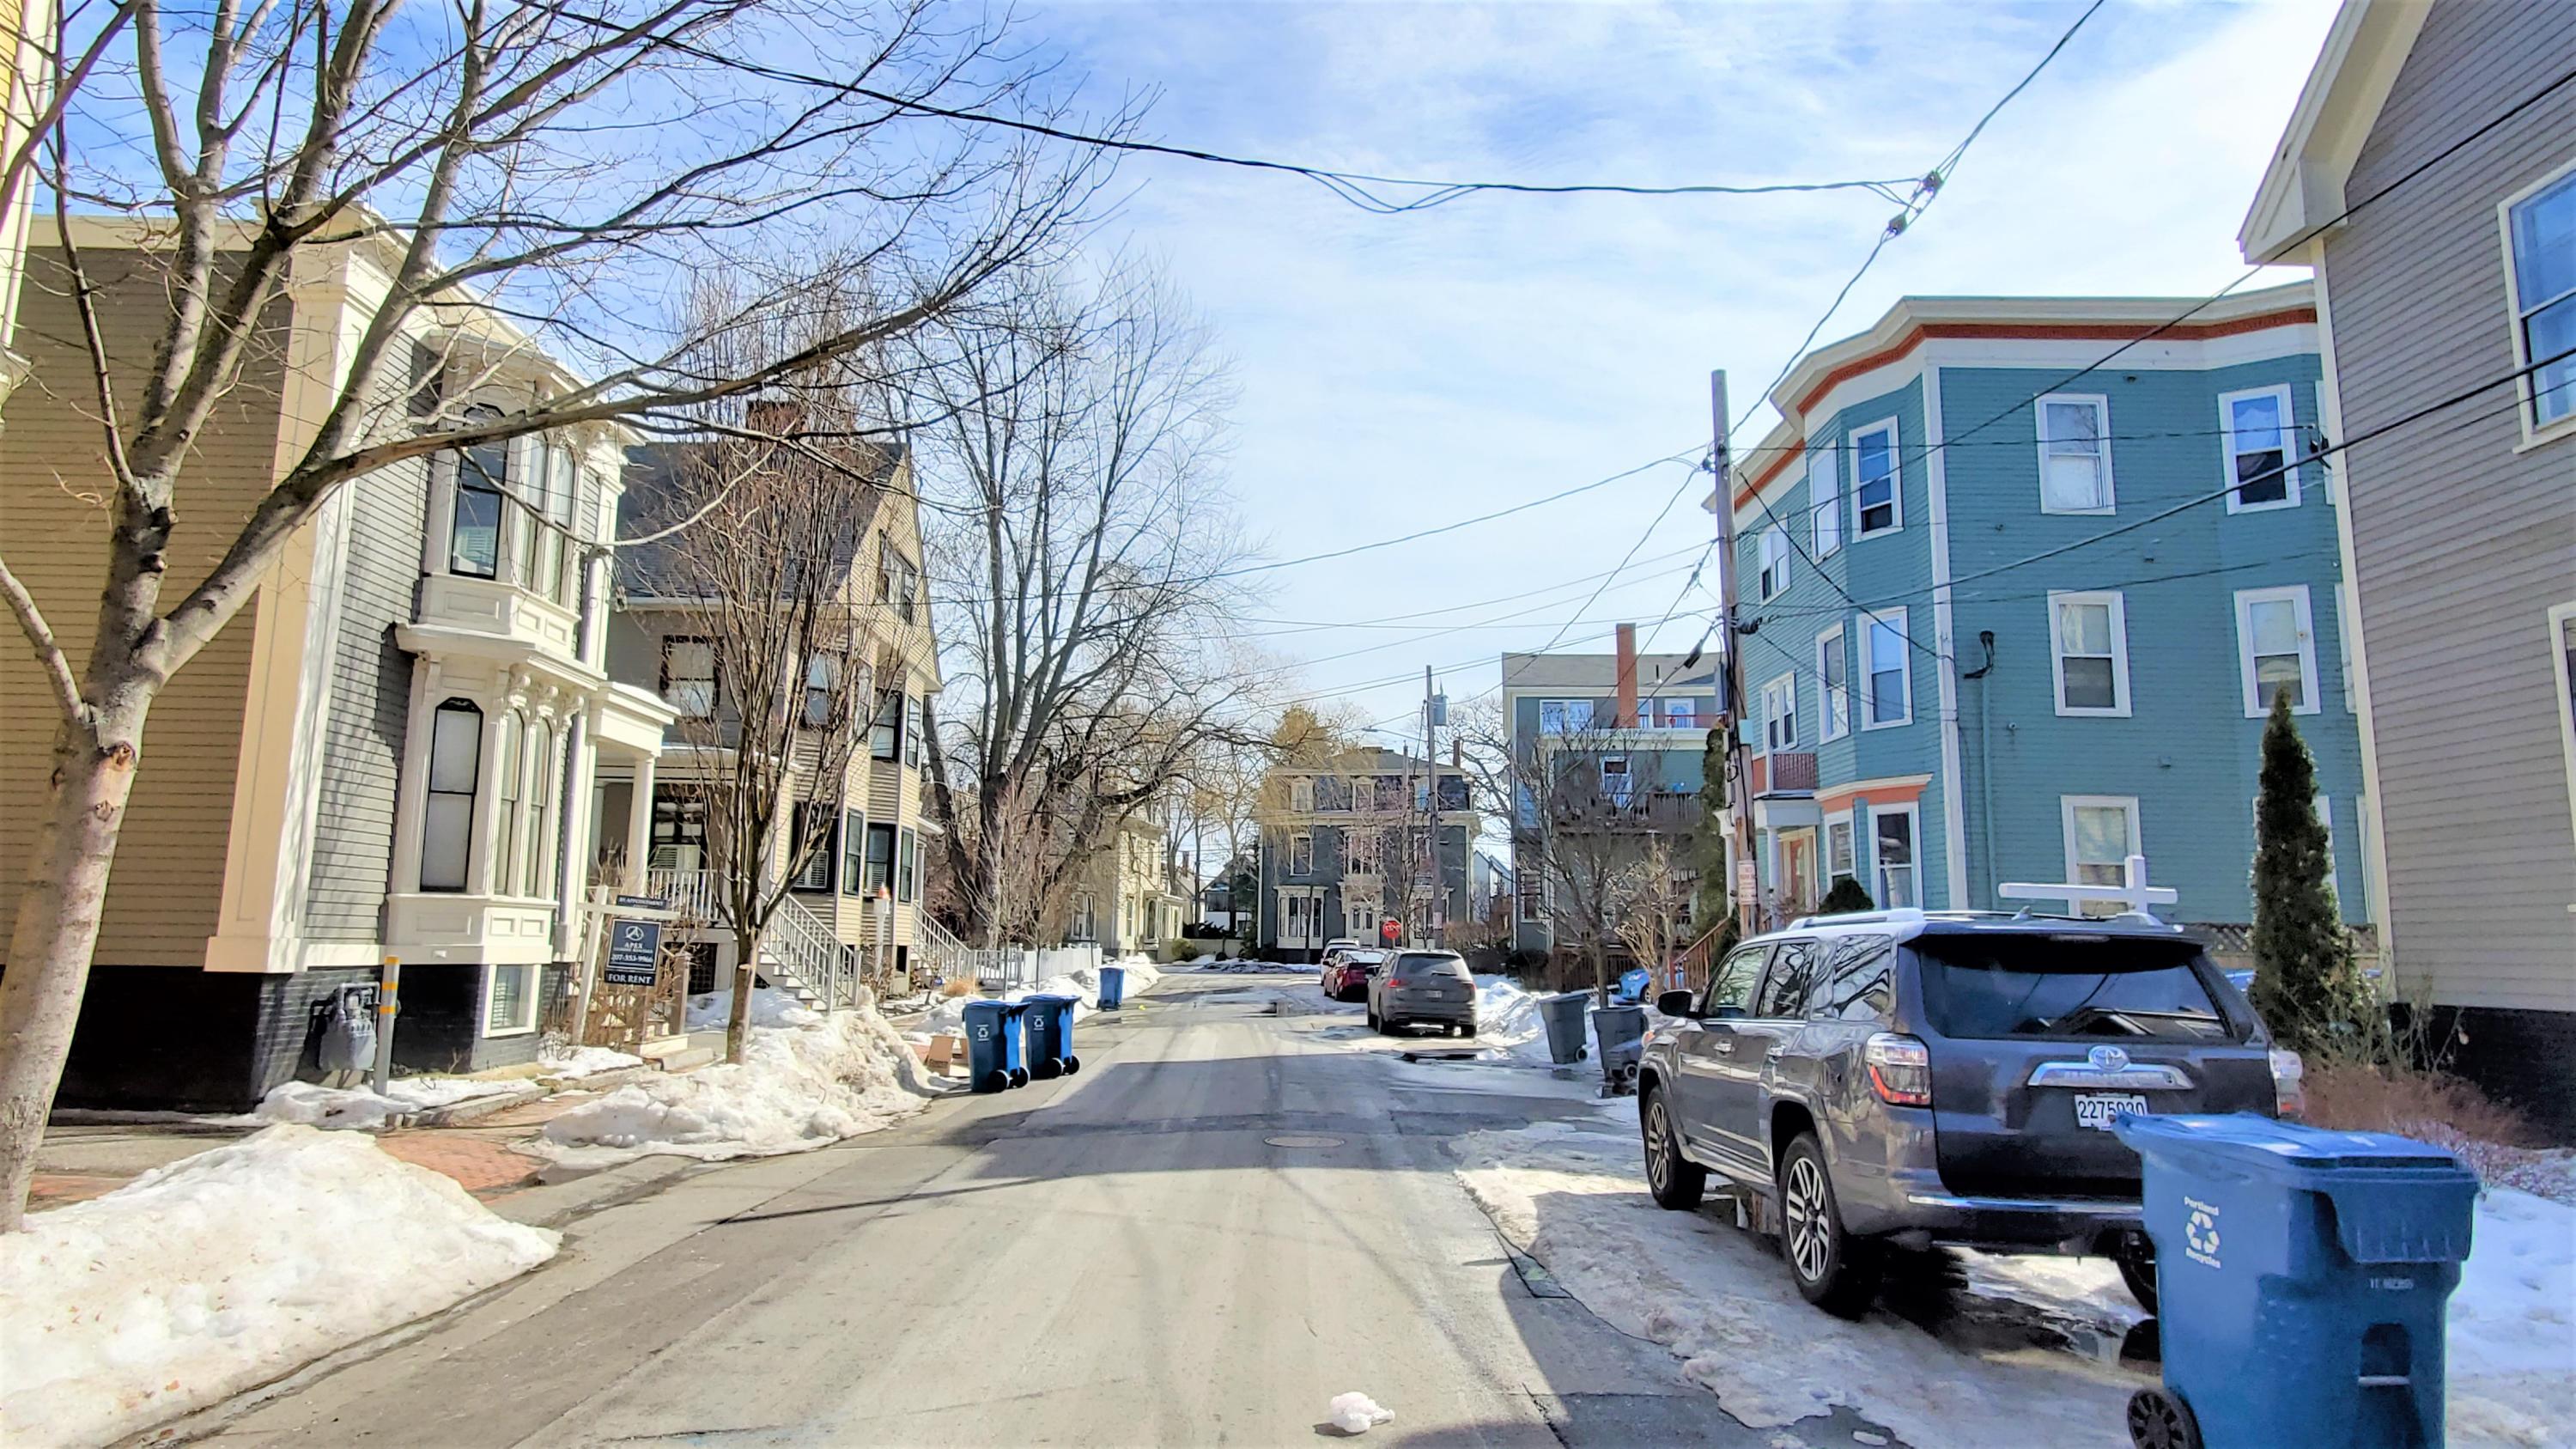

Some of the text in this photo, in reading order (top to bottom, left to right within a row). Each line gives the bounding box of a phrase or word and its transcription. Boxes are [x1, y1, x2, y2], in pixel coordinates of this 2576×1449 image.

[608, 973, 653, 984] FOR RENT
[2184, 1196, 2219, 1216] Portland
